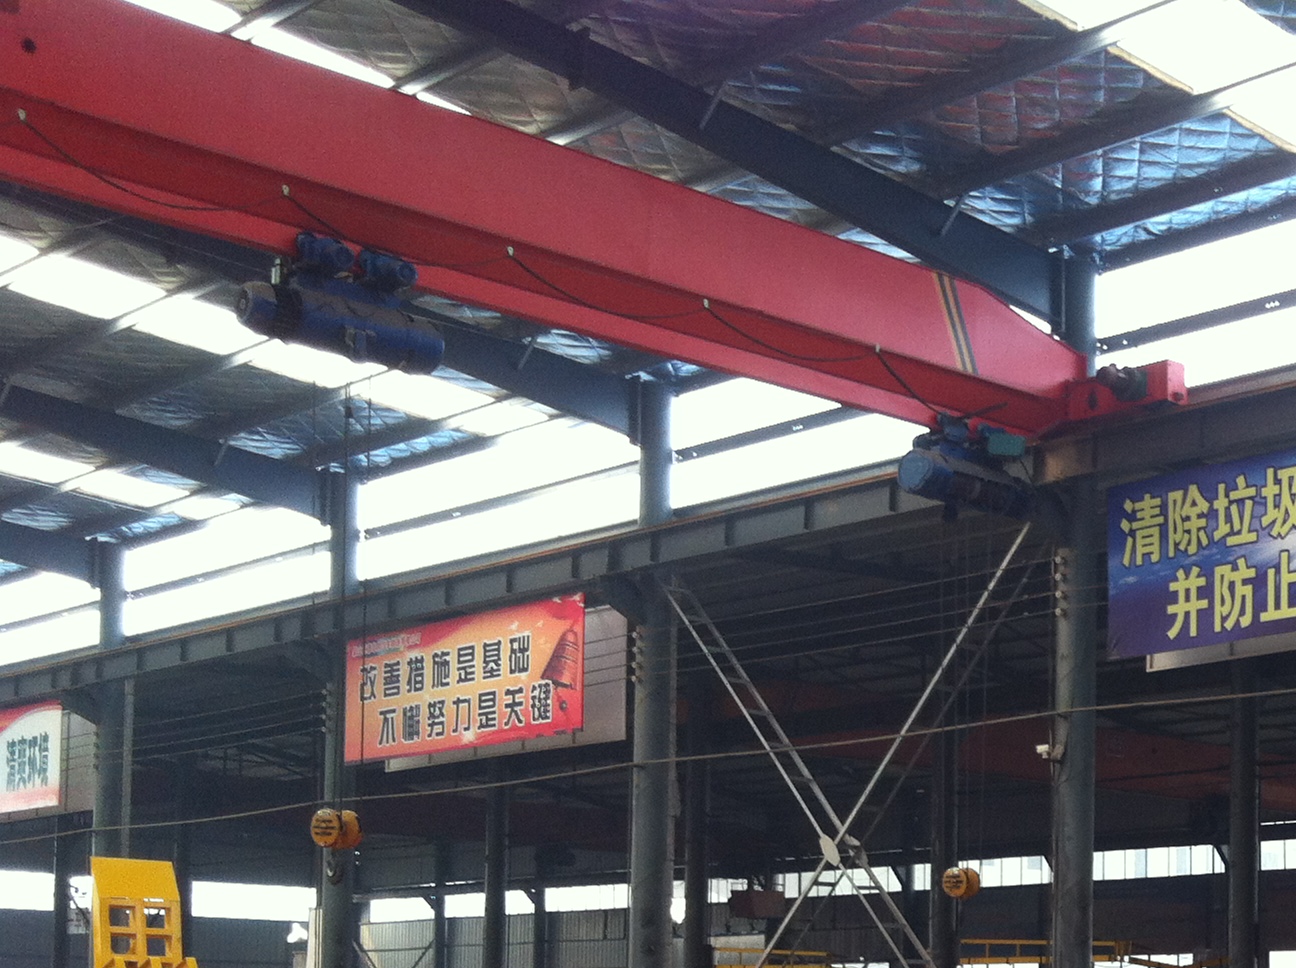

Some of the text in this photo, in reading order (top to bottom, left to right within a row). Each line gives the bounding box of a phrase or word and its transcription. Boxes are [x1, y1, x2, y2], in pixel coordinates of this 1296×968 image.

[359, 630, 532, 704] 改善措施是基础
